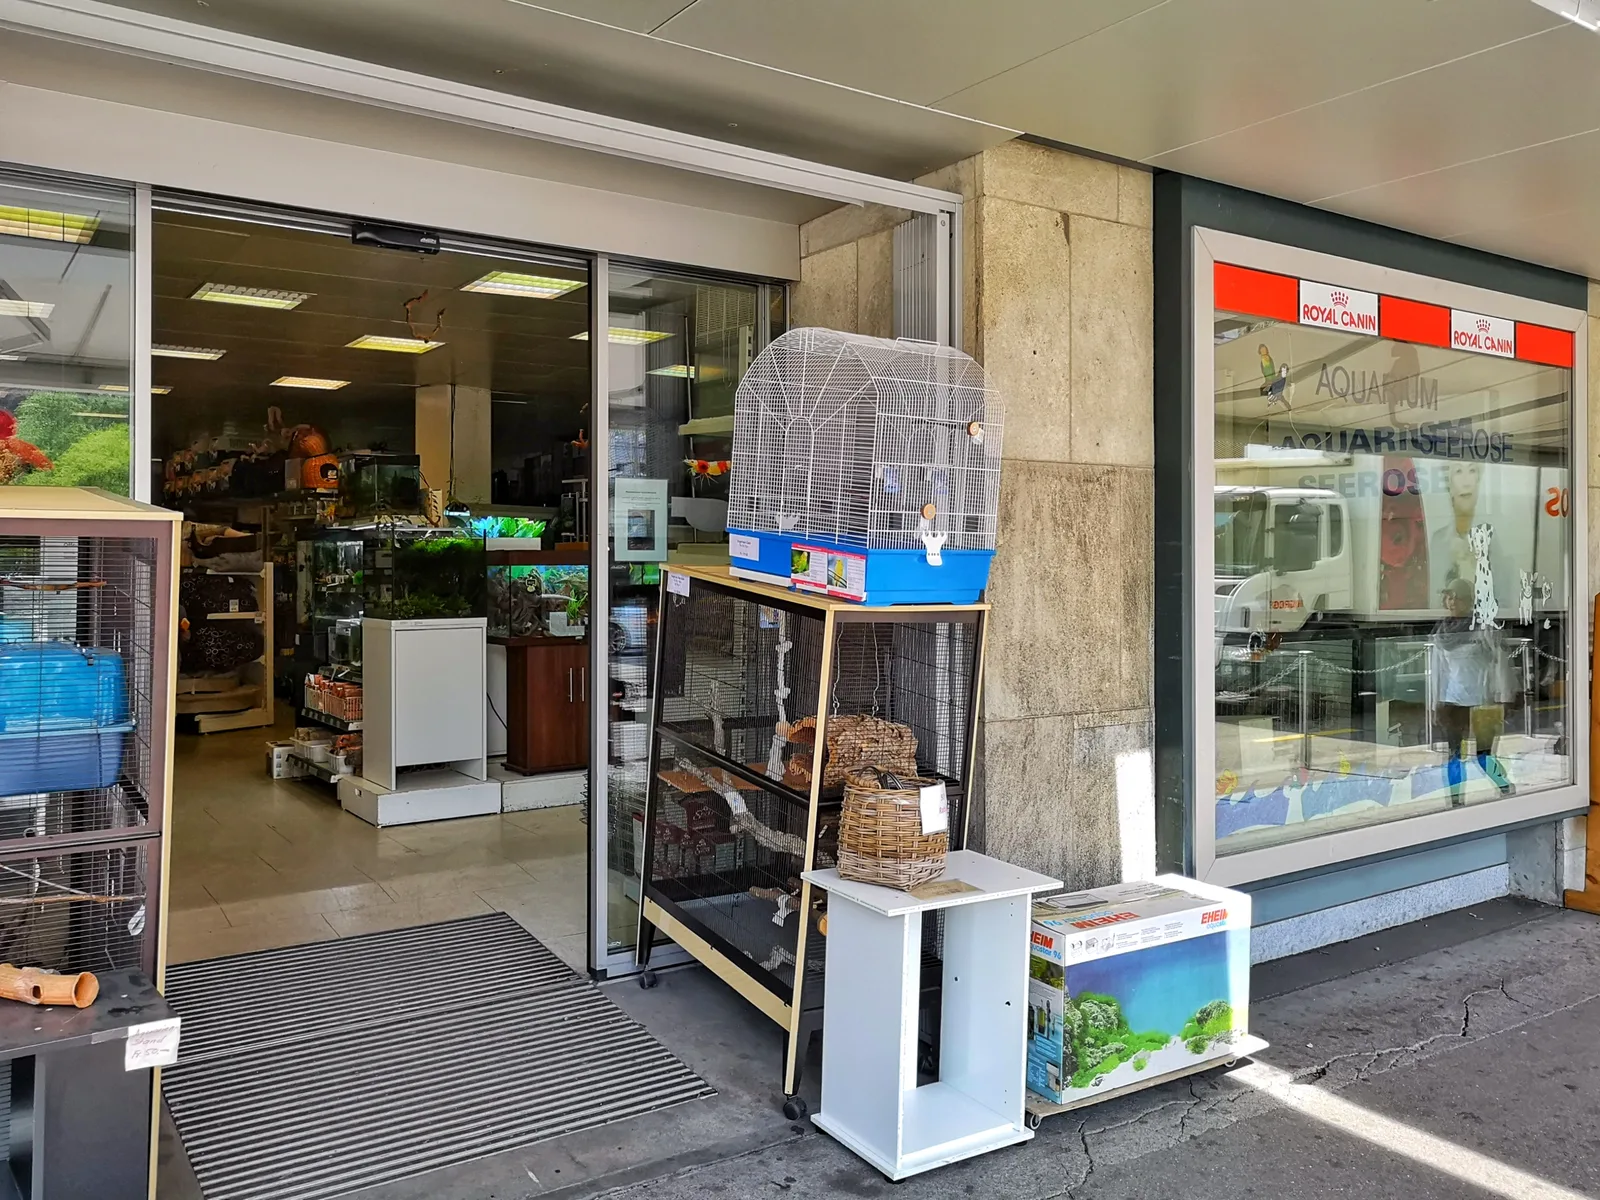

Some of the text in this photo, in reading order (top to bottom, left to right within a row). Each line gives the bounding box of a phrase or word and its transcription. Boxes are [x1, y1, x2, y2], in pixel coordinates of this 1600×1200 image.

[1303, 304, 1376, 331] ROYAL CANIN
[1454, 330, 1512, 354] ROYAL CANIN
[1315, 363, 1438, 411] AQUARUM
[1419, 421, 1514, 463] SEEROSE
[1298, 465, 1450, 499] SEEROSE
[1069, 911, 1141, 929] EHEIM
[1053, 949, 1062, 960] 96
